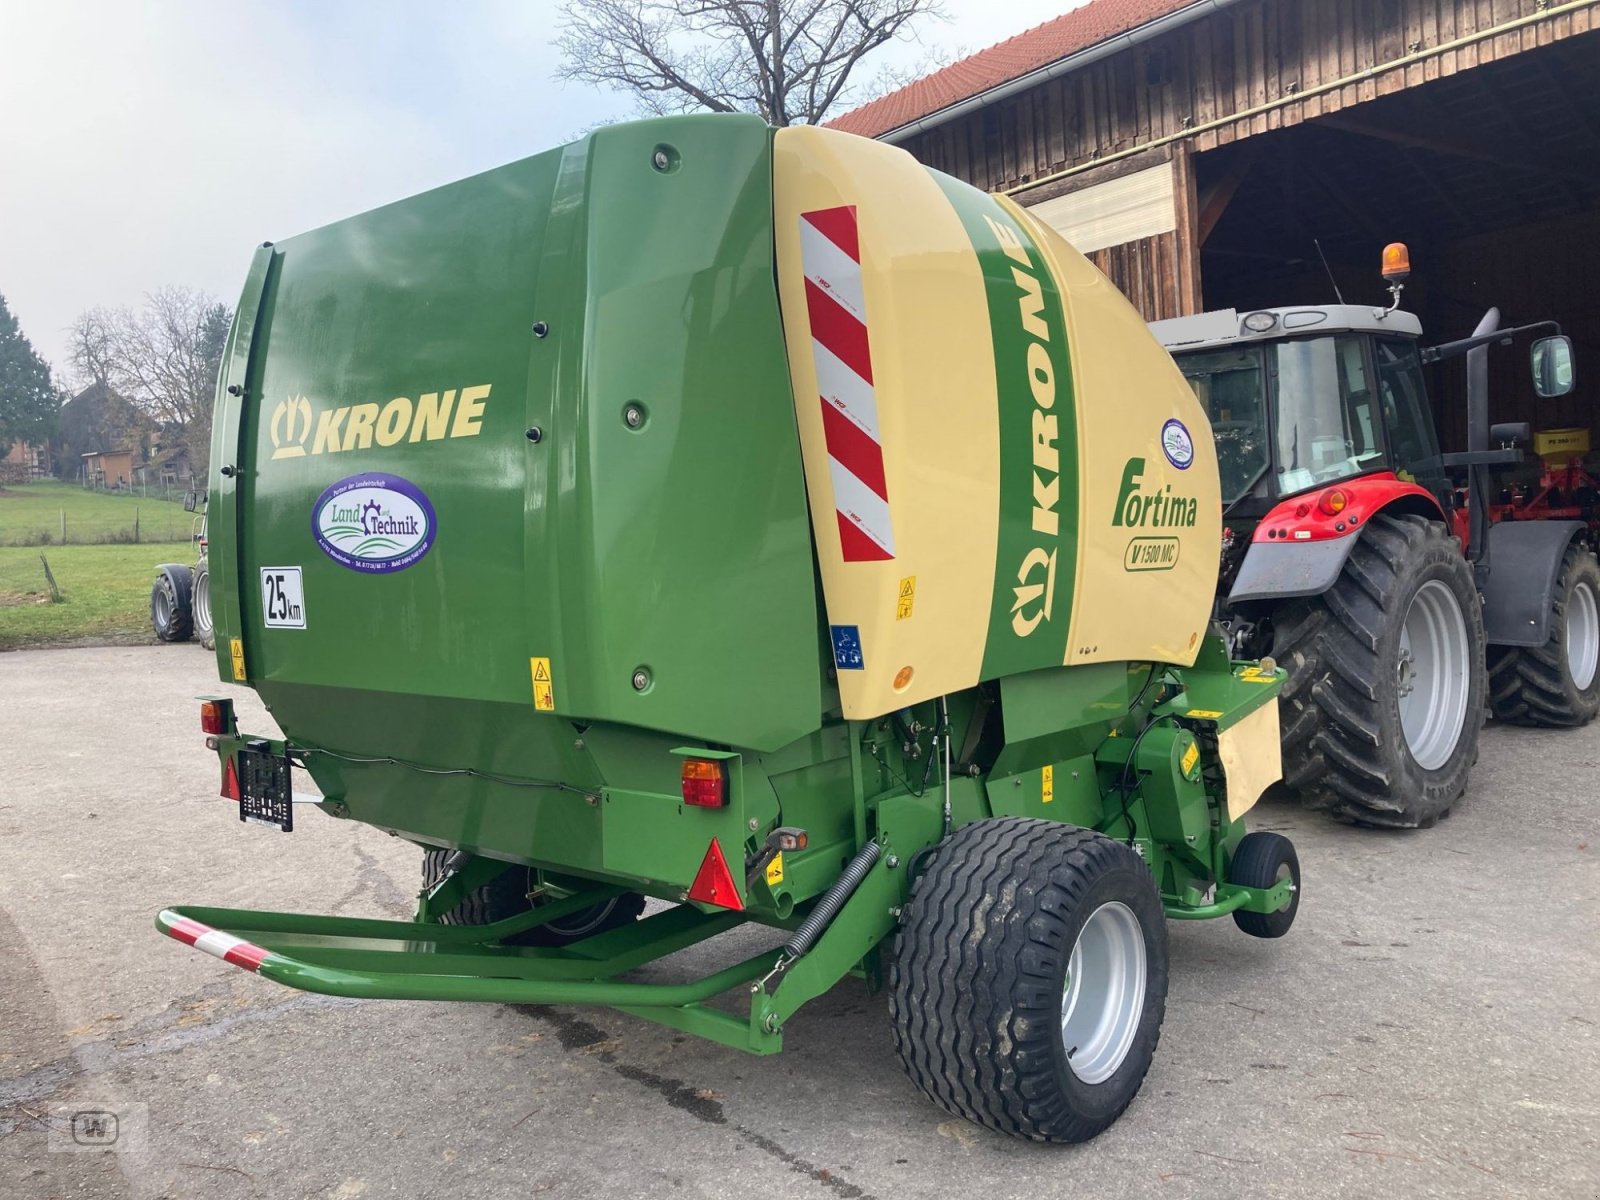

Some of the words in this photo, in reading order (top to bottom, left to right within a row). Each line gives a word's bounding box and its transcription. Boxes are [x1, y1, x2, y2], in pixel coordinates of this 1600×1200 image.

[982, 213, 1060, 536] KRONE
[311, 384, 492, 455] KRONE
[331, 504, 360, 523] Land
[1112, 457, 1197, 527] Fortima
[371, 515, 419, 535] Technik
[1131, 544, 1142, 564] V
[1140, 544, 1160, 563] 1500
[1160, 544, 1175, 563] MC
[265, 574, 287, 620] 25
[287, 599, 301, 620] km
